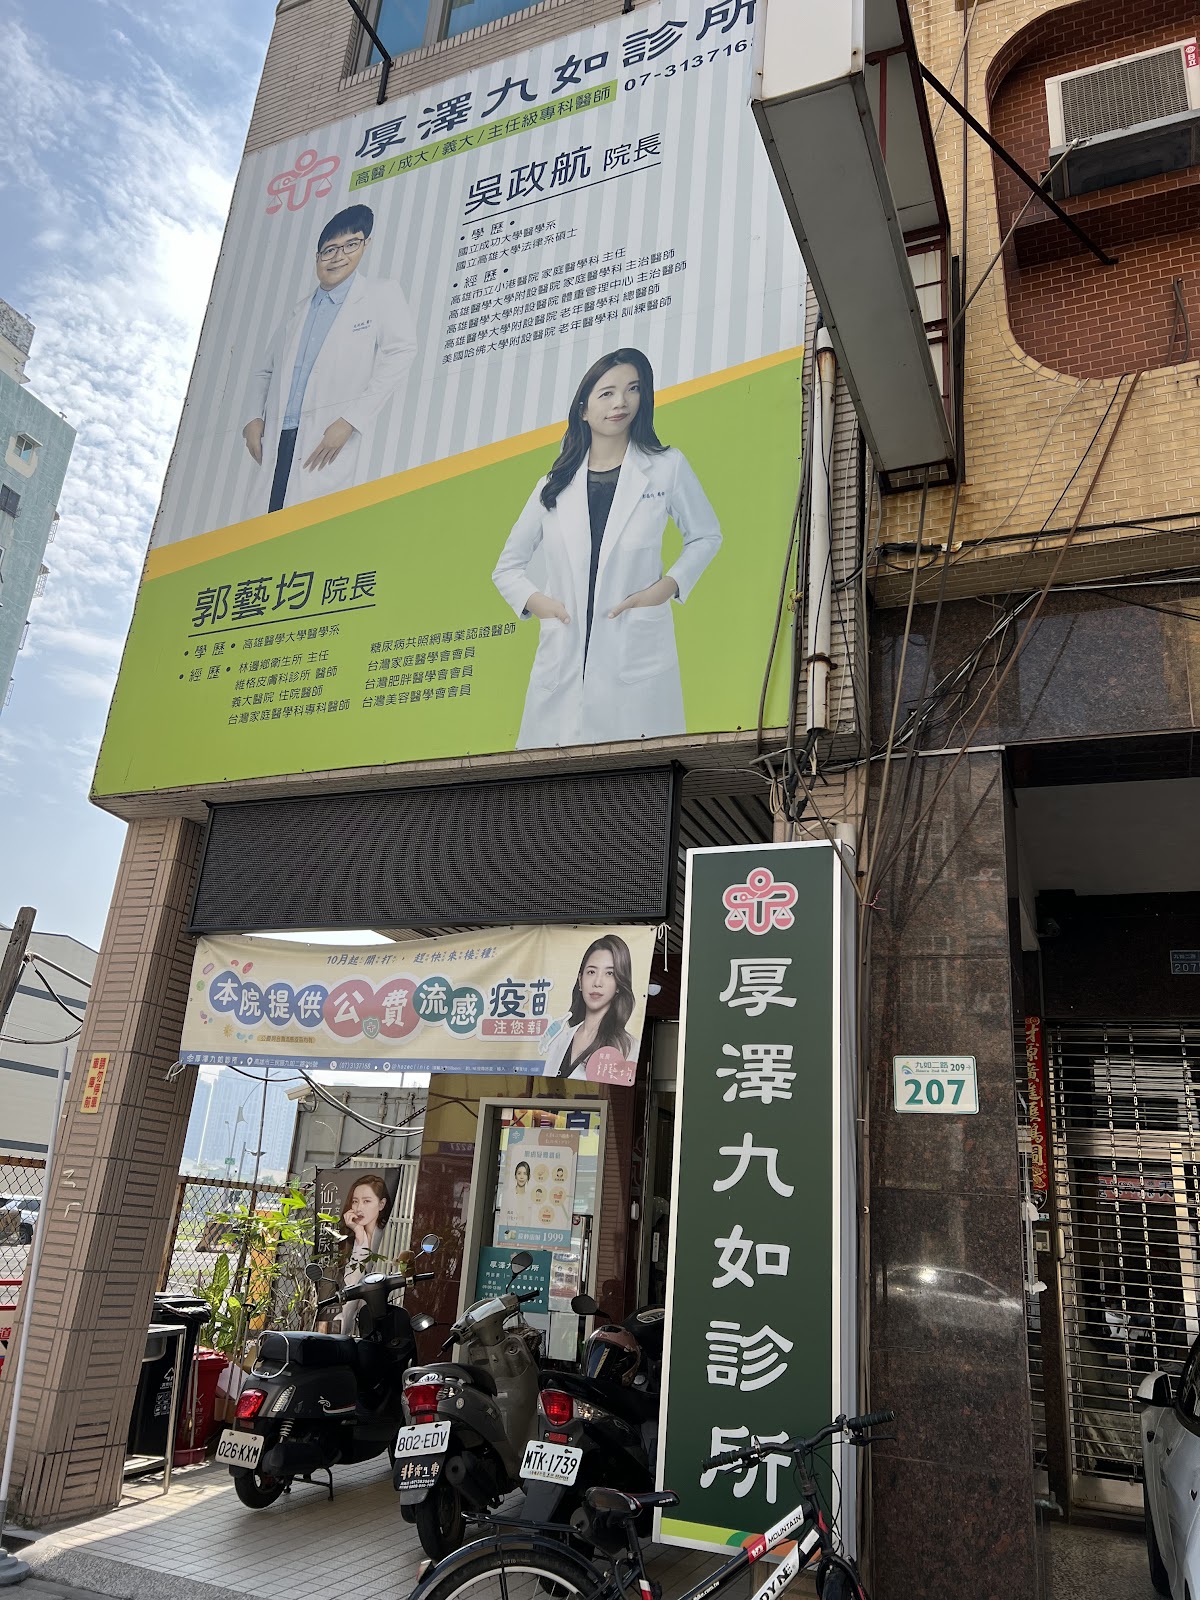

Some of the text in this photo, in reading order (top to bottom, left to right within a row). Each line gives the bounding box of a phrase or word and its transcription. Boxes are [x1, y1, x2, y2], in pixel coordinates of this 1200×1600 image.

[624, 37, 754, 92] 07-313716
[1188, 53, 1197, 66] 日立
[355, 0, 756, 160] 厚澤九如診所
[464, 133, 662, 216] 吳政航 院長
[457, 219, 557, 258] 國立成功大學醫學系
[471, 221, 504, 241] 學歷
[455, 228, 578, 272] 國立高雄大學法律系碩士
[448, 248, 675, 320] 高雄醫學大學附設醫院 家庭醫學科 主治醫師
[450, 247, 626, 306] 高雄市立小港醫院 家庭醫學科 主任
[464, 269, 497, 289] 經歷
[446, 260, 687, 334] 高雄醫學大學附設醫院 體重管理中心 主治醫師
[441, 295, 672, 365] 美國哈佛大學附設醫院 老年醫學科 訓練醫師
[444, 282, 660, 349] 高雄醫學大學附設醫院 老年醫學科 總醫師
[192, 570, 377, 628] 郭藝均 院長
[194, 624, 340, 659] 學歷 高雄醫學大學醫學系
[369, 622, 516, 654] 糖尿病共照網專業認證醫師
[189, 665, 221, 682] 經歷
[306, 649, 329, 664] 主任
[315, 665, 338, 680] 醫師
[367, 646, 476, 672] 台灣家庭醫學會會員
[364, 665, 474, 690] 台灣肥胖醫學會會員
[231, 685, 323, 708] 義大醫院 住院醫師
[361, 683, 472, 709] 台灣美容醫學會會員
[227, 698, 350, 726] 台灣家庭醫學科專科醫師
[1175, 963, 1197, 972] 207
[915, 1061, 966, 1072] 九如二路 209
[904, 1079, 966, 1105] 207
[543, 1232, 564, 1242] 1999
[700, 957, 797, 1504] 厚澤九如診所
[218, 1440, 260, 1464] 026-KXM
[397, 1431, 448, 1452] 802-EDV
[523, 1450, 578, 1476] MTK-1739
[768, 1514, 802, 1544] MOUNTAIN
